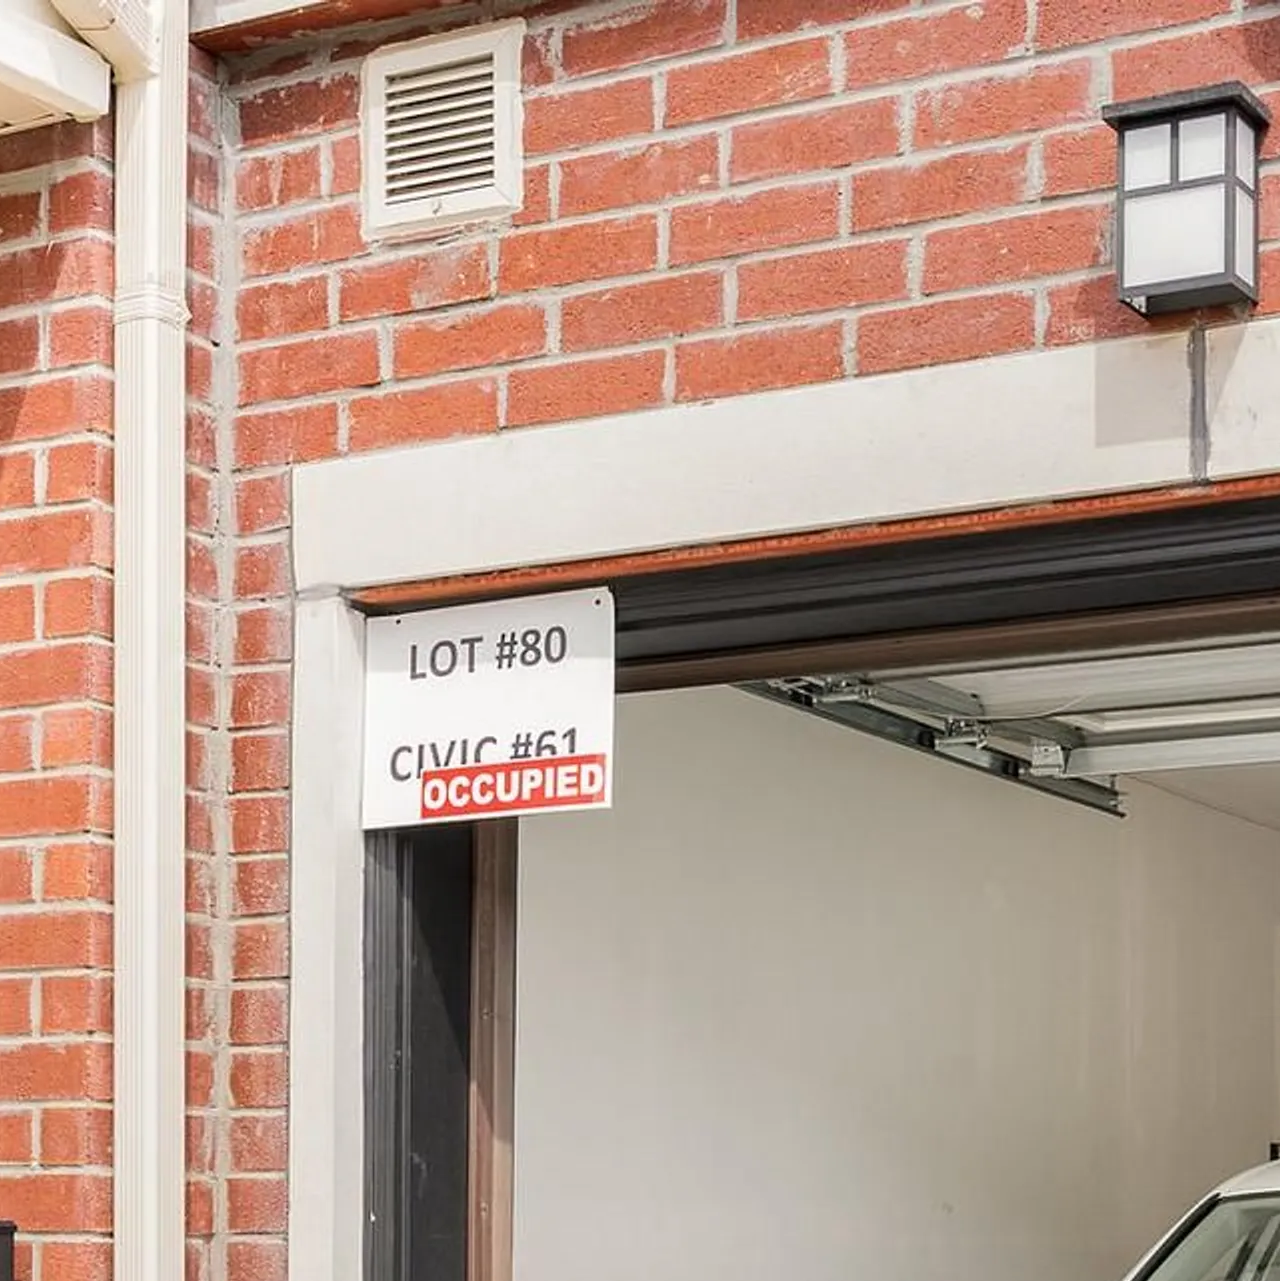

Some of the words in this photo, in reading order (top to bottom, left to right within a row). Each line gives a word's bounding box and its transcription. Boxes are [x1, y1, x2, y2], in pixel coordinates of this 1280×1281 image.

[409, 635, 484, 681] LOT
[495, 625, 568, 670] #80
[389, 735, 498, 782] CIVIC
[509, 726, 578, 761] #61
[423, 763, 604, 810] OCCUPIED
